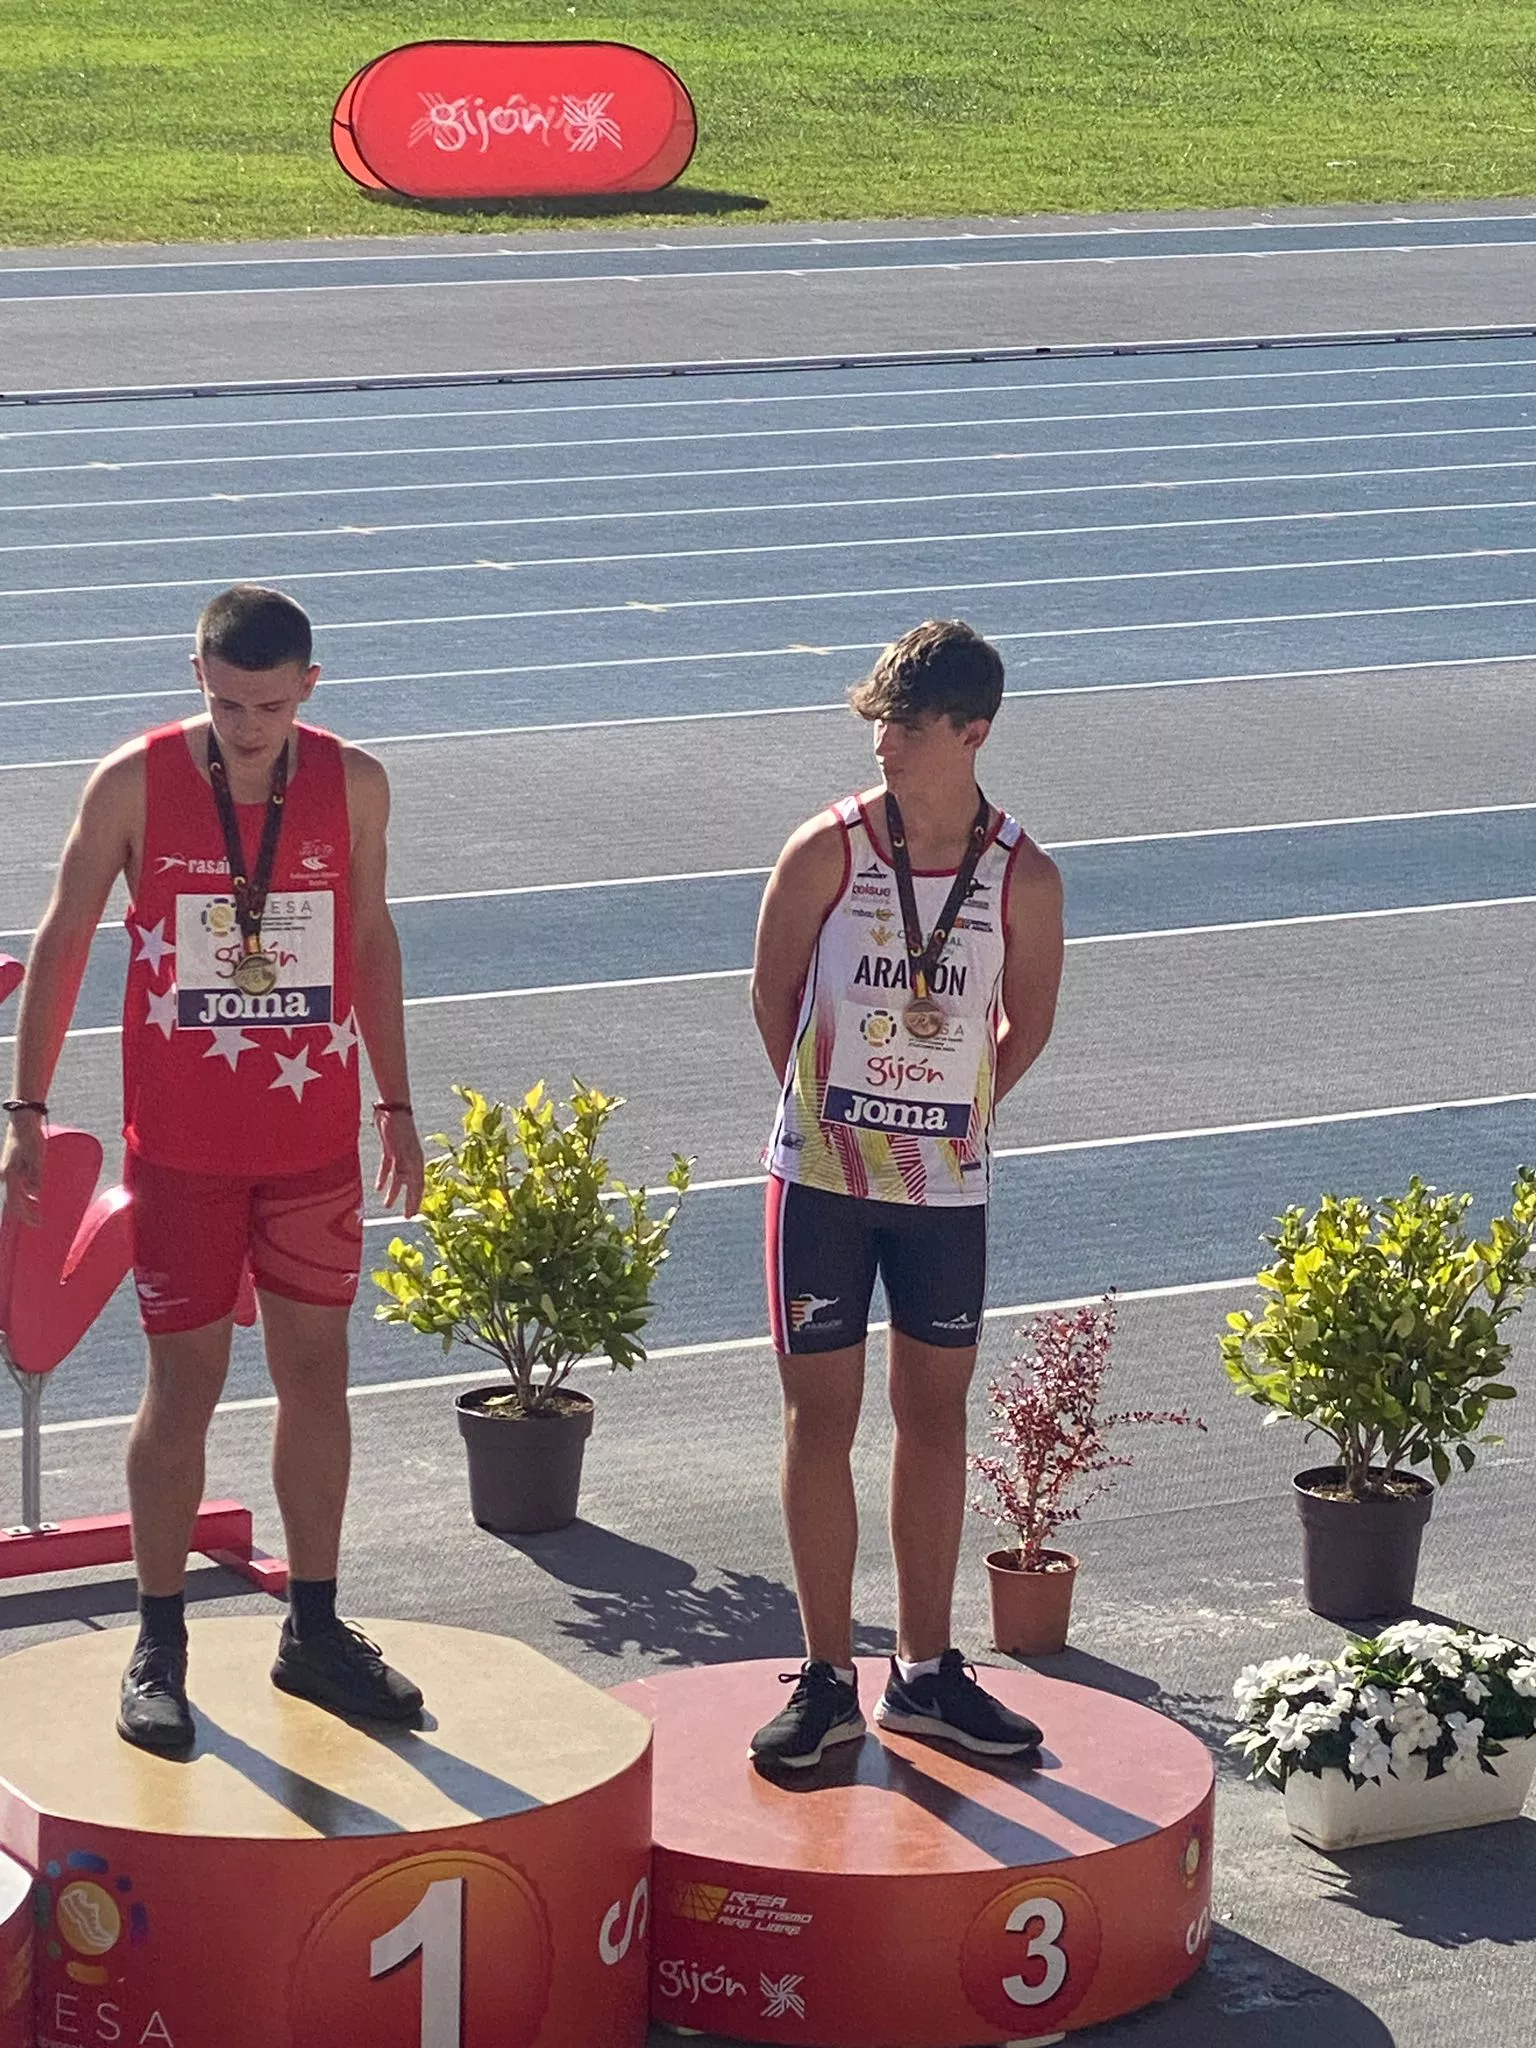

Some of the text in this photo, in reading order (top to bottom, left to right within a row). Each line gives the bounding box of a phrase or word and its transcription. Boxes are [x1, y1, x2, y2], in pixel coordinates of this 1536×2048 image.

[270, 900, 313, 914] ESA
[853, 954, 968, 997] ARAÓN
[865, 1055, 945, 1090] gijón
[844, 1095, 948, 1131] Joma
[370, 1877, 463, 2048] 1
[1002, 1897, 1068, 2006] 3
[659, 1960, 748, 2004] gijón
[55, 1992, 175, 2048] ESA
